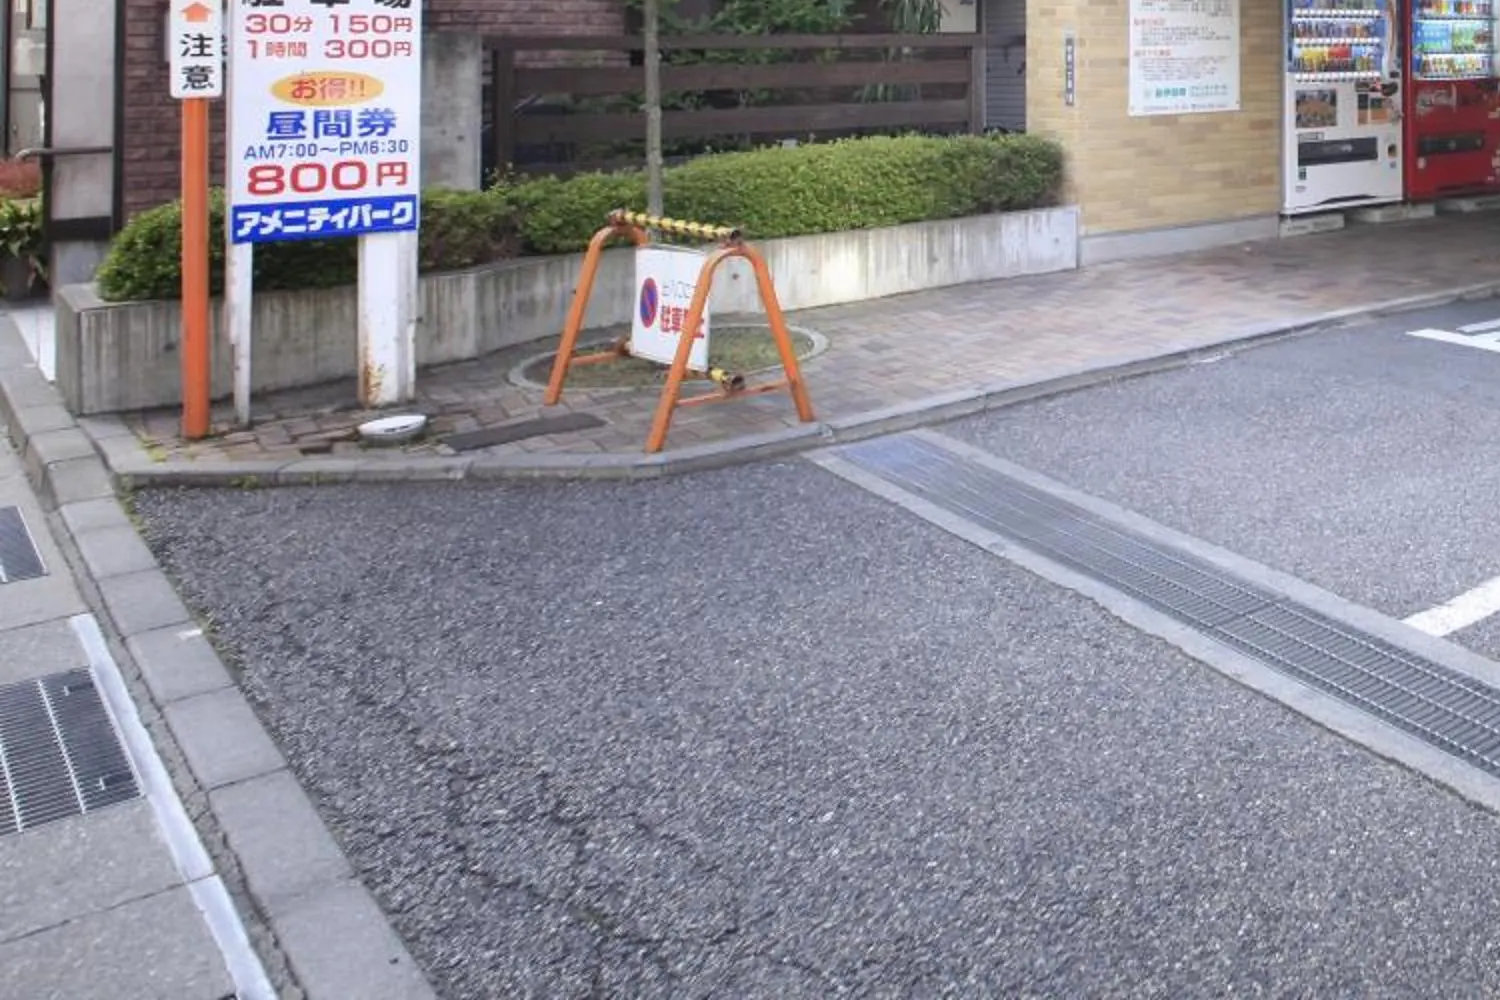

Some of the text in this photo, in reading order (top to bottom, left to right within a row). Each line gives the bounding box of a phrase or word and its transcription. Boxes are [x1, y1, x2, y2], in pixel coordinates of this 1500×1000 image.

[244, 13, 413, 34] 30分 150円
[179, 33, 214, 91] 注意
[246, 39, 308, 60] 1時間
[323, 39, 412, 59] 300円
[266, 107, 399, 141] 昼間券
[247, 160, 409, 197] 800円
[236, 201, 414, 238] アメニティパーク
